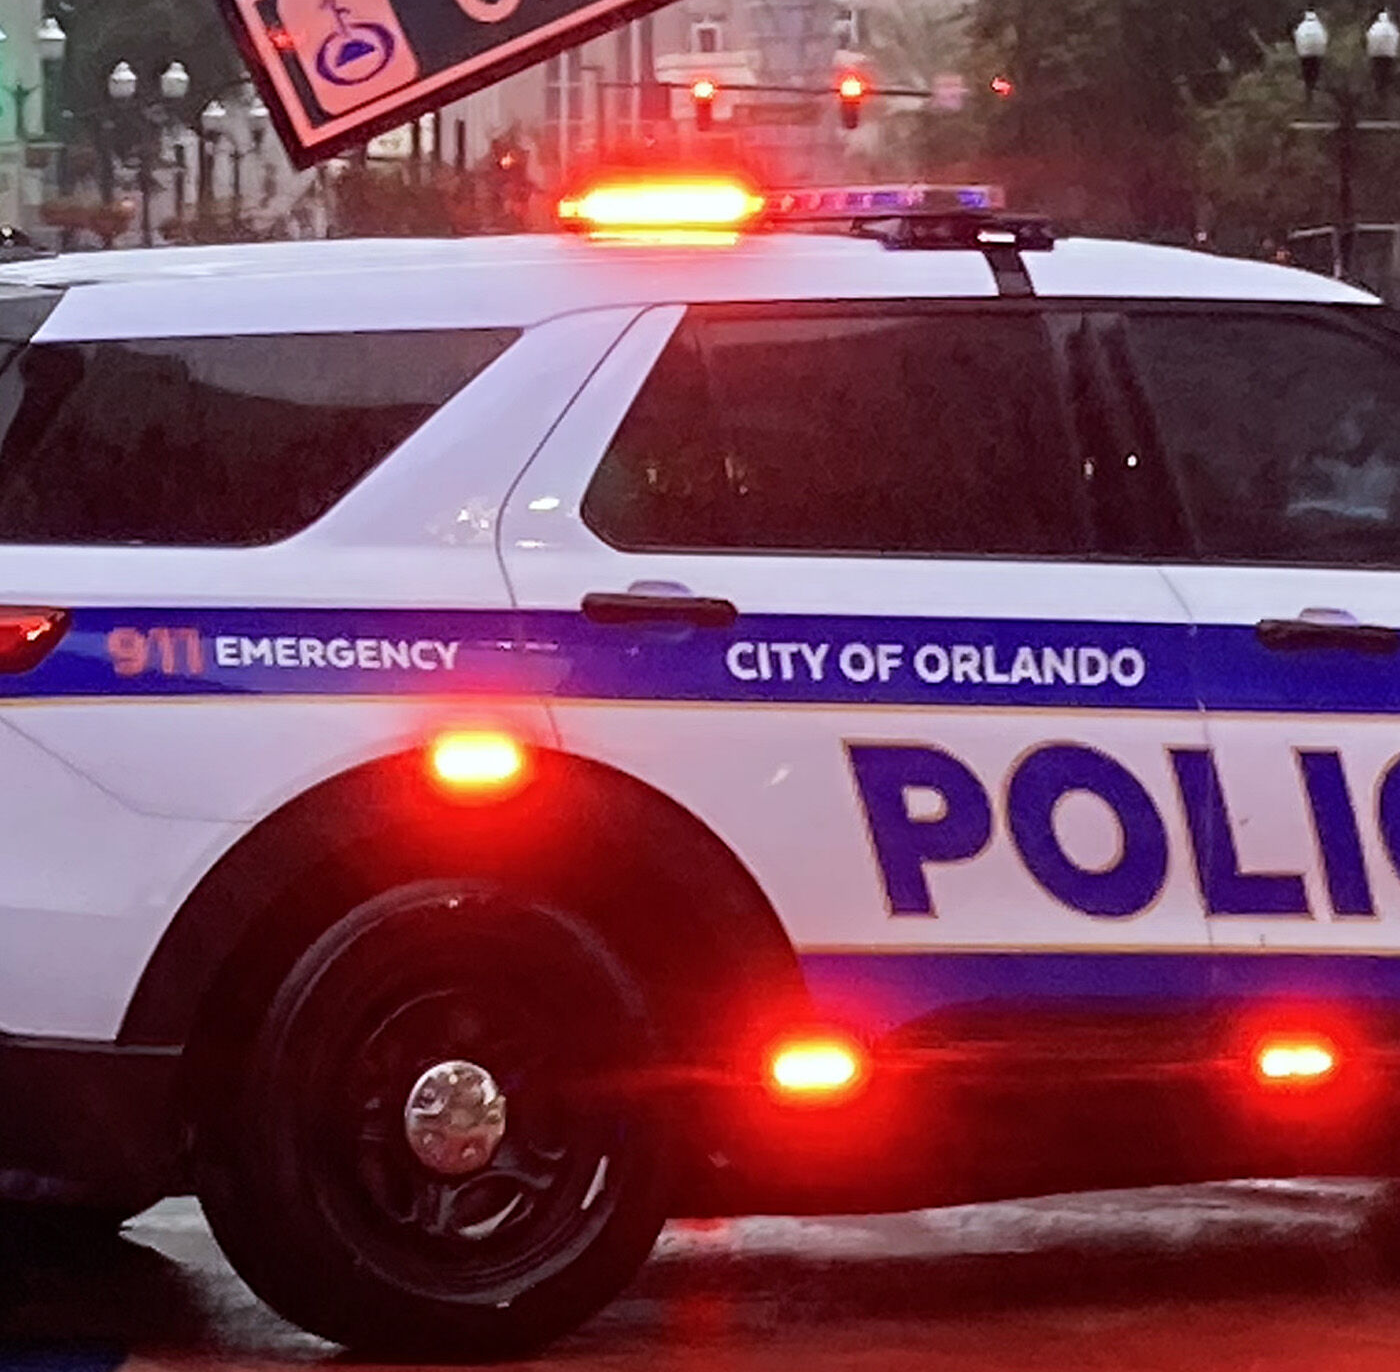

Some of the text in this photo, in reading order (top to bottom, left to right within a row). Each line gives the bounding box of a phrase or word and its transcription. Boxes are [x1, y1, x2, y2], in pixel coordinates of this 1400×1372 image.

[108, 627, 460, 676] 911 EMERGENCY
[726, 641, 1147, 688] CITY OF ORLANDO
